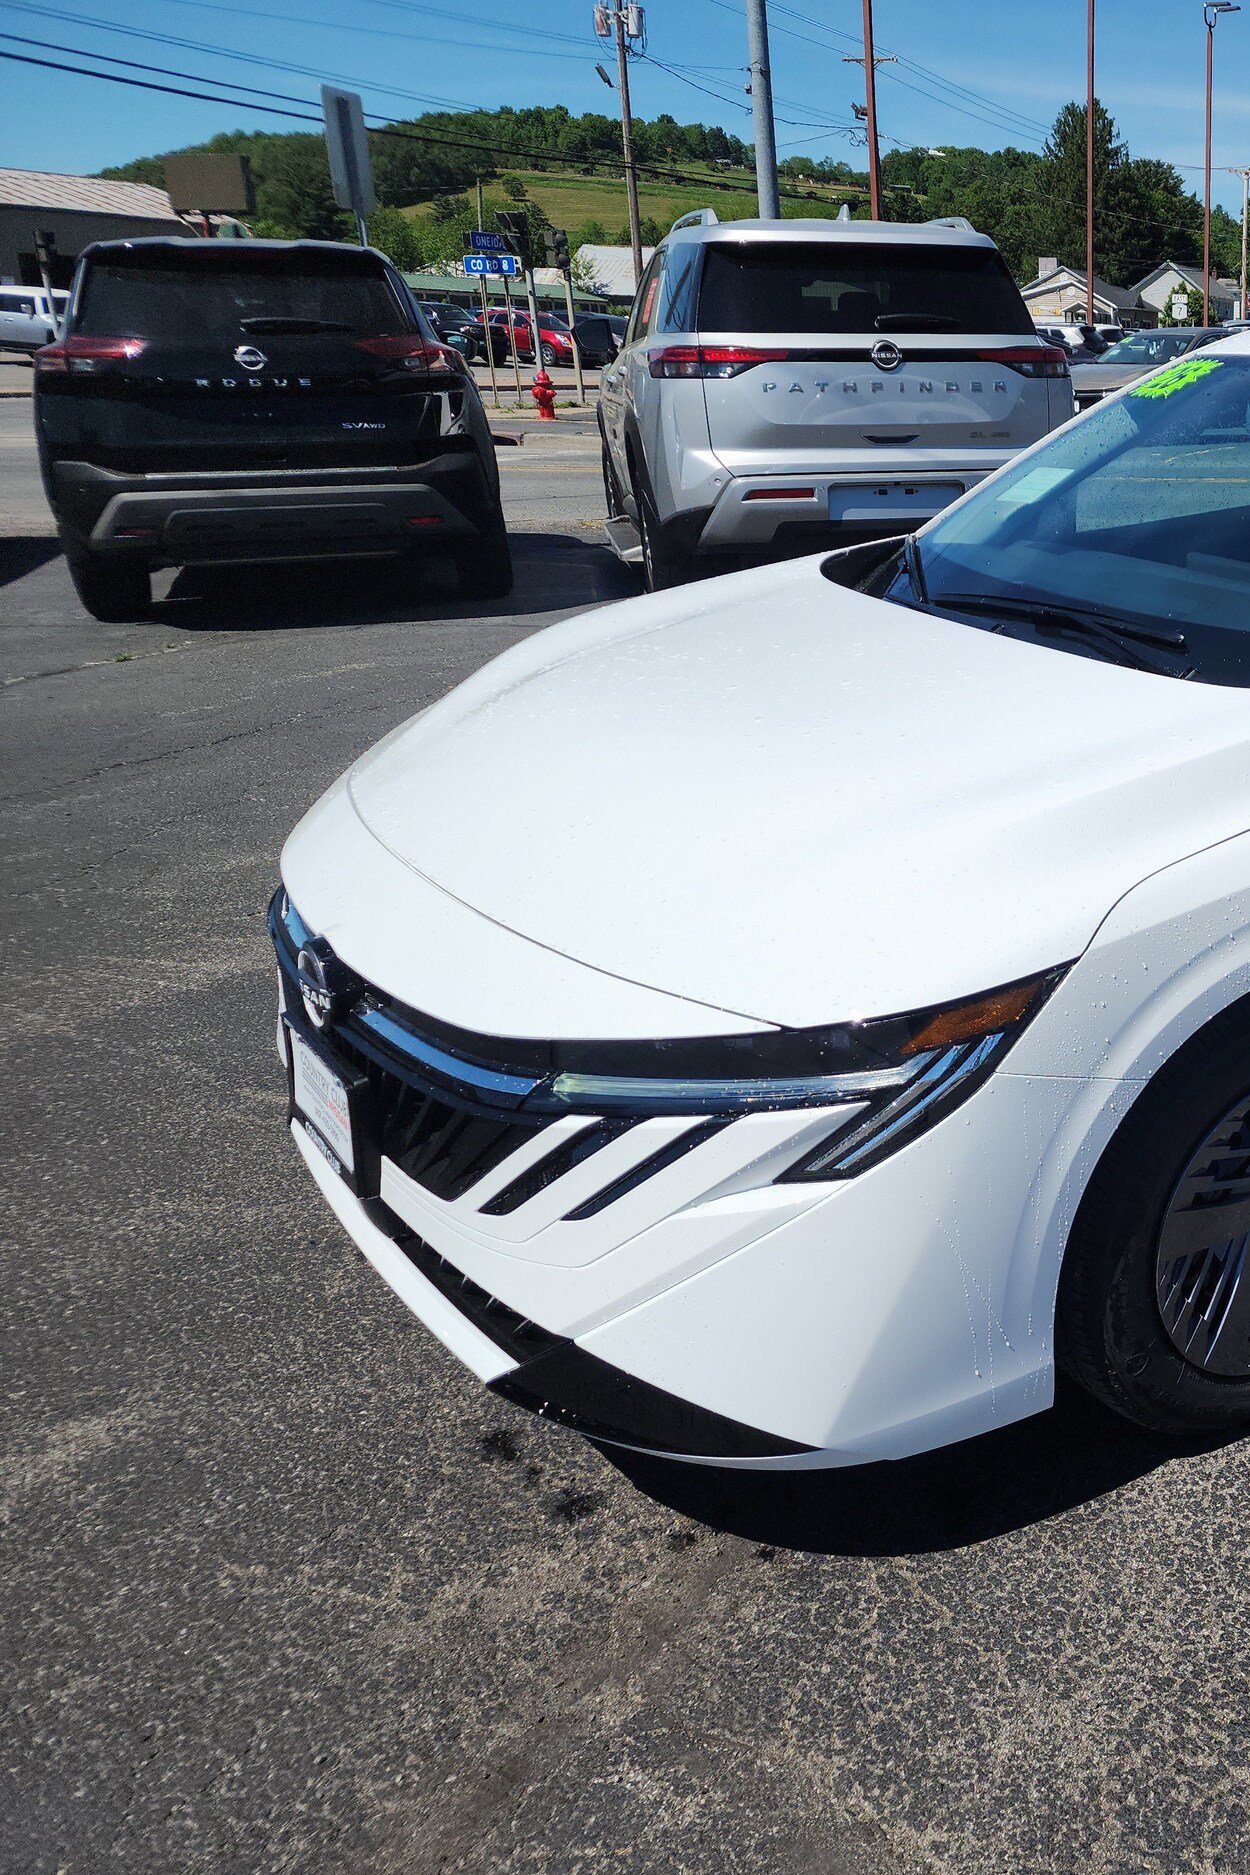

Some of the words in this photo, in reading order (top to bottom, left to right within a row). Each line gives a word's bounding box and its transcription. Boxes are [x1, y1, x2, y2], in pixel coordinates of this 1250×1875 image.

[470, 259, 483, 270] CO
[486, 259, 499, 271] RD
[502, 259, 509, 271] 8
[1177, 306, 1183, 316] 7
[195, 377, 311, 387] ROGUE
[760, 380, 1008, 395] PATHFINDER
[342, 422, 364, 430] SV
